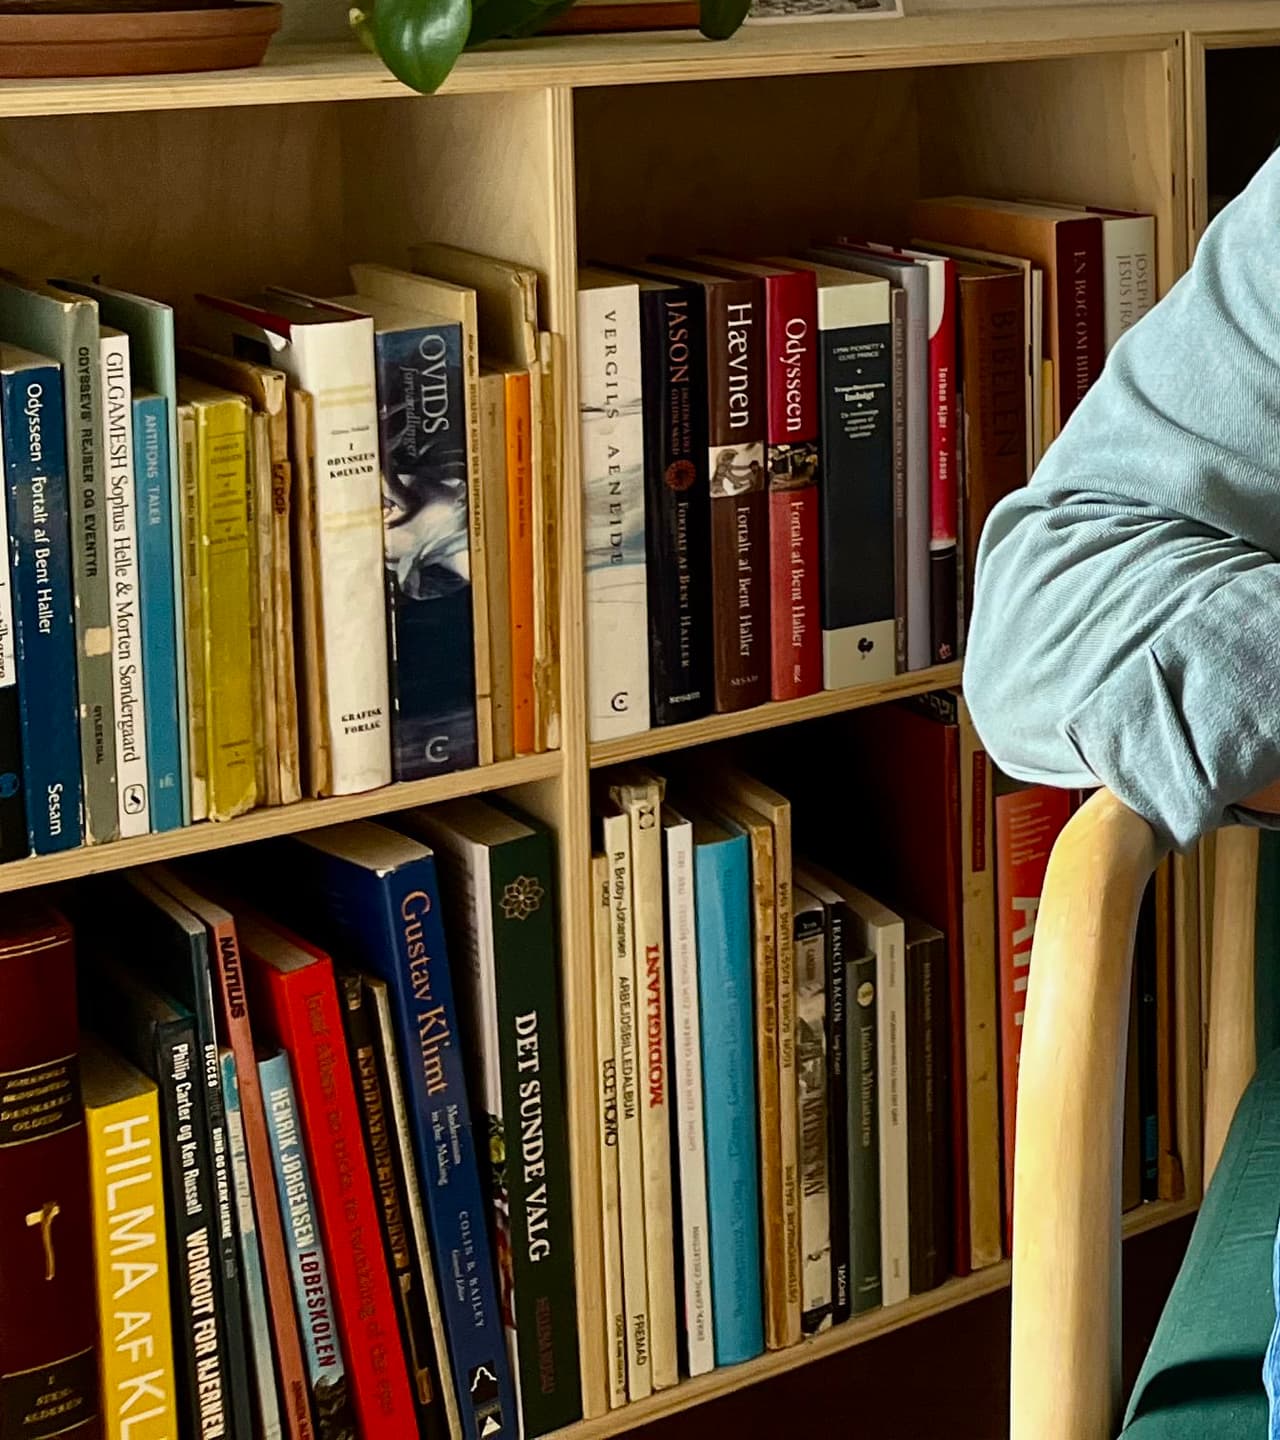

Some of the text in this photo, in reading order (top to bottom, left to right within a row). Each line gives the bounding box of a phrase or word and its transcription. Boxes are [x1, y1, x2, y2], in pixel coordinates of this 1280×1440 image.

[1116, 256, 1132, 296] JESUS
[1135, 254, 1148, 309] JOSEPH
[665, 300, 689, 382] JASON
[726, 302, 753, 429] Hævnen
[779, 318, 808, 432] Odysseen
[418, 334, 450, 434] OVIDS
[991, 310, 1019, 457] BIBELEN
[81, 429, 95, 482] REJSER
[144, 415, 158, 478] ANTIFONS
[603, 310, 623, 564] VERGILS AENEIDE
[938, 450, 950, 480] Jesus
[24, 383, 53, 634] Odysseen Fortalt af Bent Haller
[83, 489, 96, 508] OG
[84, 515, 97, 577] EVENTYR
[106, 352, 140, 763] GILGAMESH Sophus Helle & Morten Søndergaard
[737, 506, 753, 656] Fortalt af Bent Haller
[790, 501, 805, 647] Fortalt af Bent Haller
[92, 705, 104, 765] GYLDENDAL
[48, 783, 63, 836] Sesam
[219, 936, 246, 1019] NAUTILUS
[613, 852, 634, 1120] R. Broby-Johansen ARBEJDSBILLEDALBUM
[831, 919, 842, 974] FRANCIS
[399, 889, 451, 1096] Gustav Klimt
[645, 943, 664, 1109] MODIGLIANI
[832, 977, 842, 1022] BACON
[171, 1043, 190, 1081] Philip
[174, 1083, 195, 1122] Carter
[176, 1124, 193, 1142] og
[181, 1143, 198, 1167] Ken
[270, 1087, 297, 1151] HENRIK
[515, 1010, 551, 1262] DET SUNDE VALG
[183, 1171, 203, 1216] Russell
[281, 1152, 315, 1249] JØRGENSEN
[103, 1115, 168, 1440] HILMA AF KL
[185, 1227, 214, 1317] WORKOUT
[299, 1251, 337, 1368] LØBESKOLEN
[458, 1210, 474, 1256] COLIN
[469, 1277, 485, 1328] BAILEY
[193, 1319, 217, 1355] FOR
[633, 1314, 647, 1366] FREMAD
